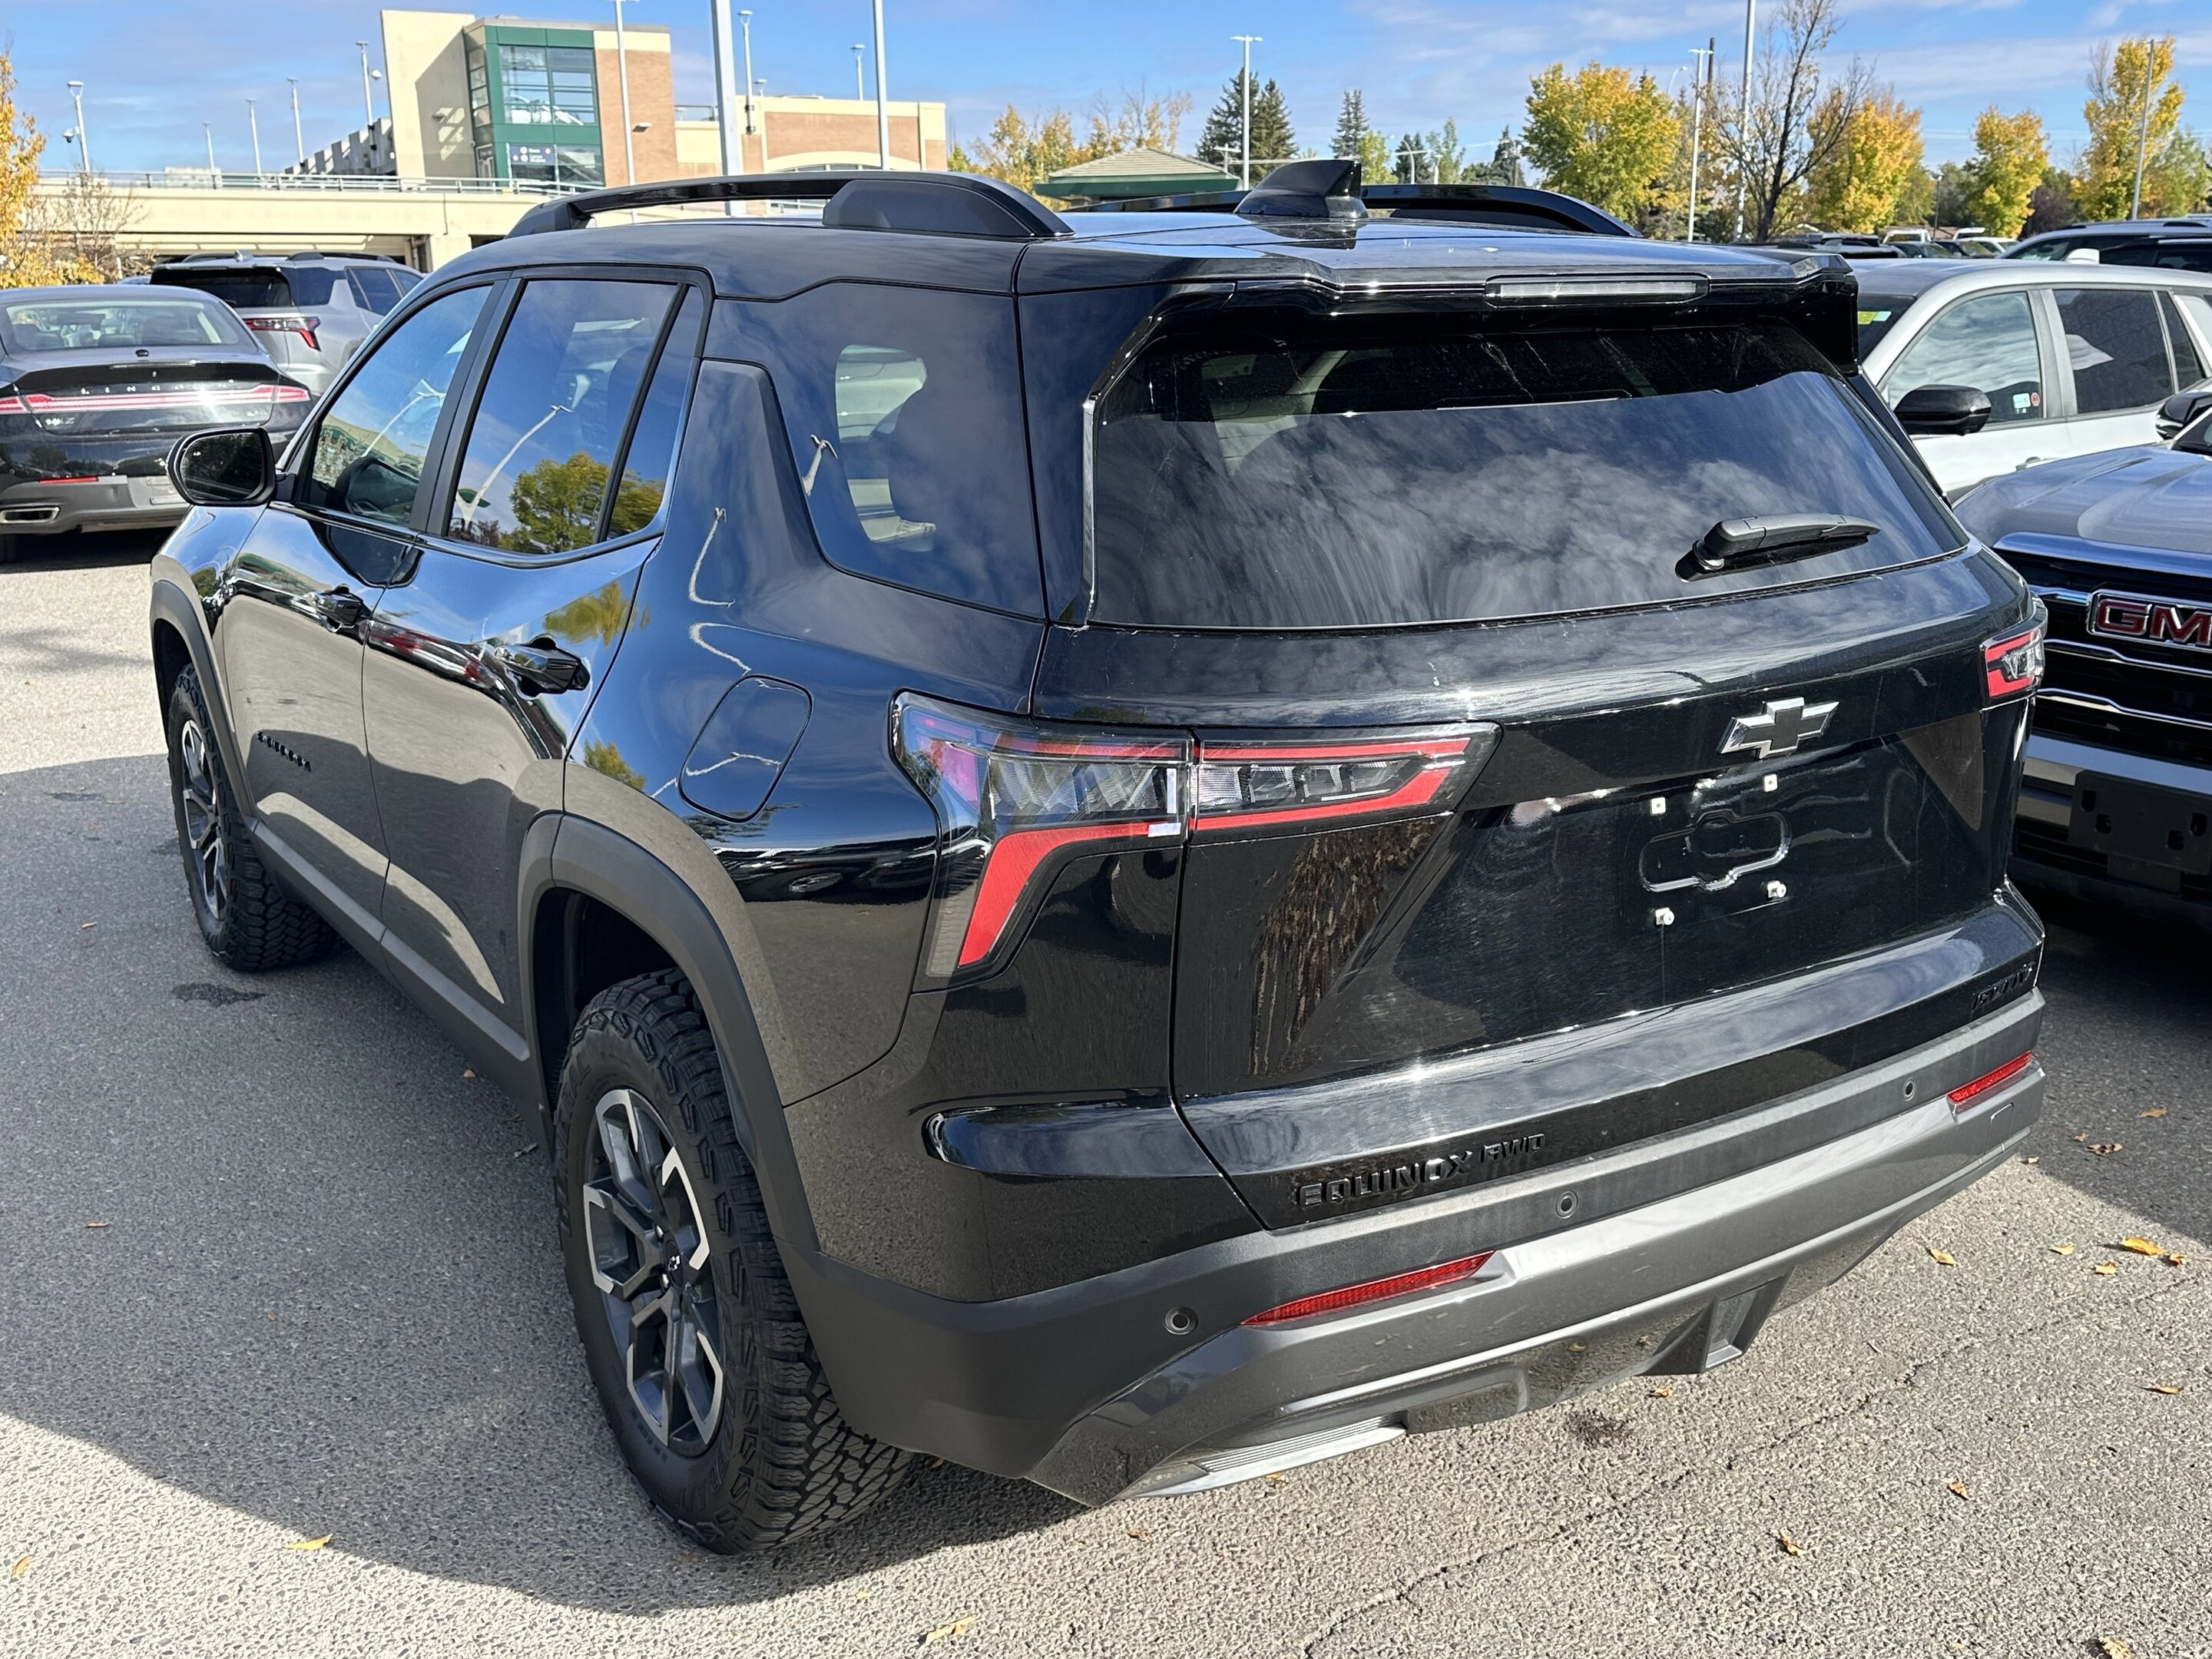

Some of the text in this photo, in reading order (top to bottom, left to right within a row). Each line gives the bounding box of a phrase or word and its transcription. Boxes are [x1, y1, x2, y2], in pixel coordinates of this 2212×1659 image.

[2096, 599, 2212, 646] GM
[1296, 1132, 1545, 1205] EQUINOX AWD
